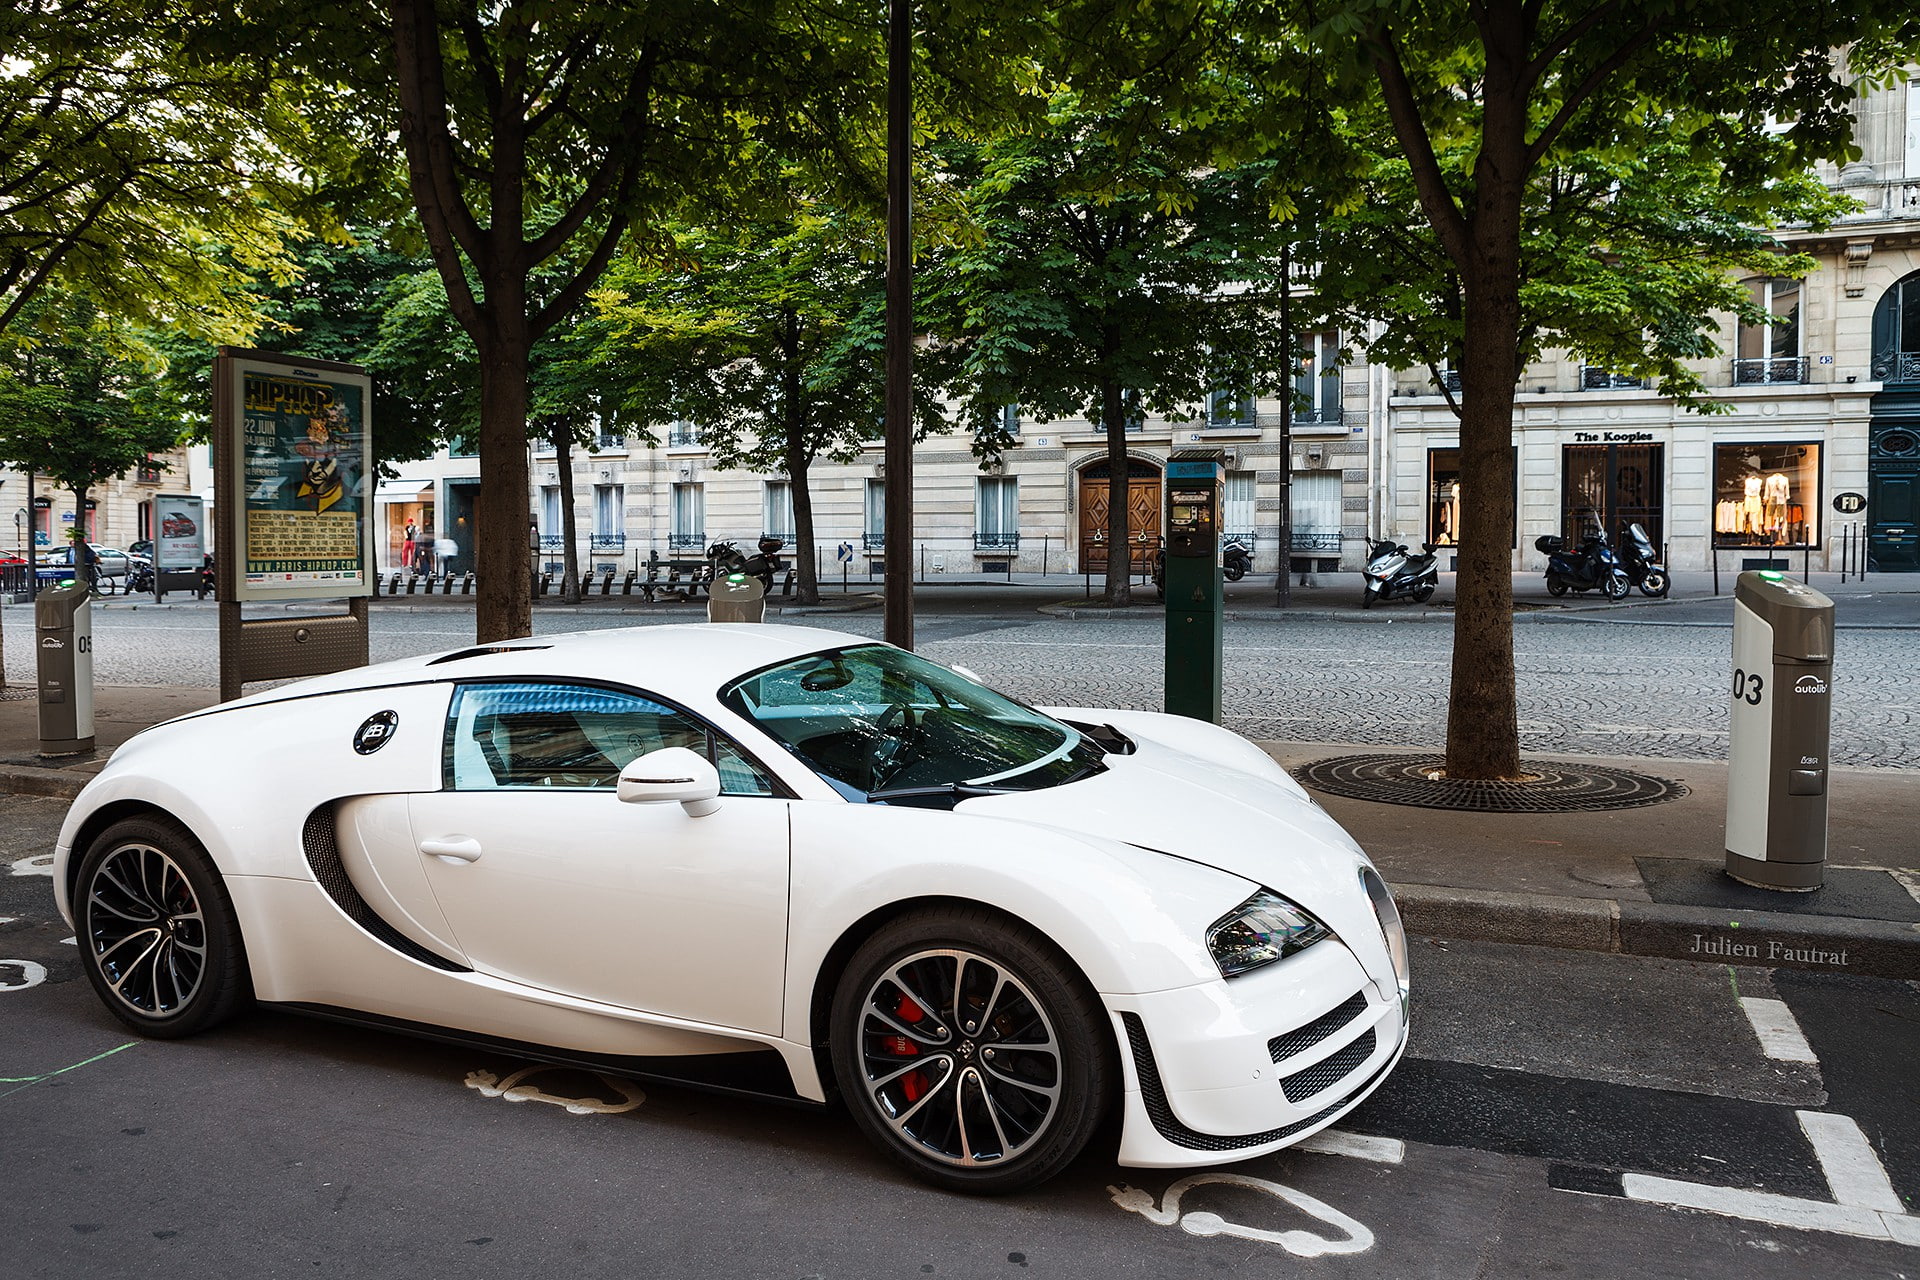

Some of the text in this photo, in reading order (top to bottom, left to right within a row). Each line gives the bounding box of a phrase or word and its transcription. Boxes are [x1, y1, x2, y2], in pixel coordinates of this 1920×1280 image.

[244, 418, 276, 435] 22 JUIN
[1575, 431, 1653, 443] The Kooples
[1841, 496, 1859, 510] FD
[248, 560, 358, 572] WWW.PARIS-HIPHOP.COM
[1733, 668, 1764, 706] 03
